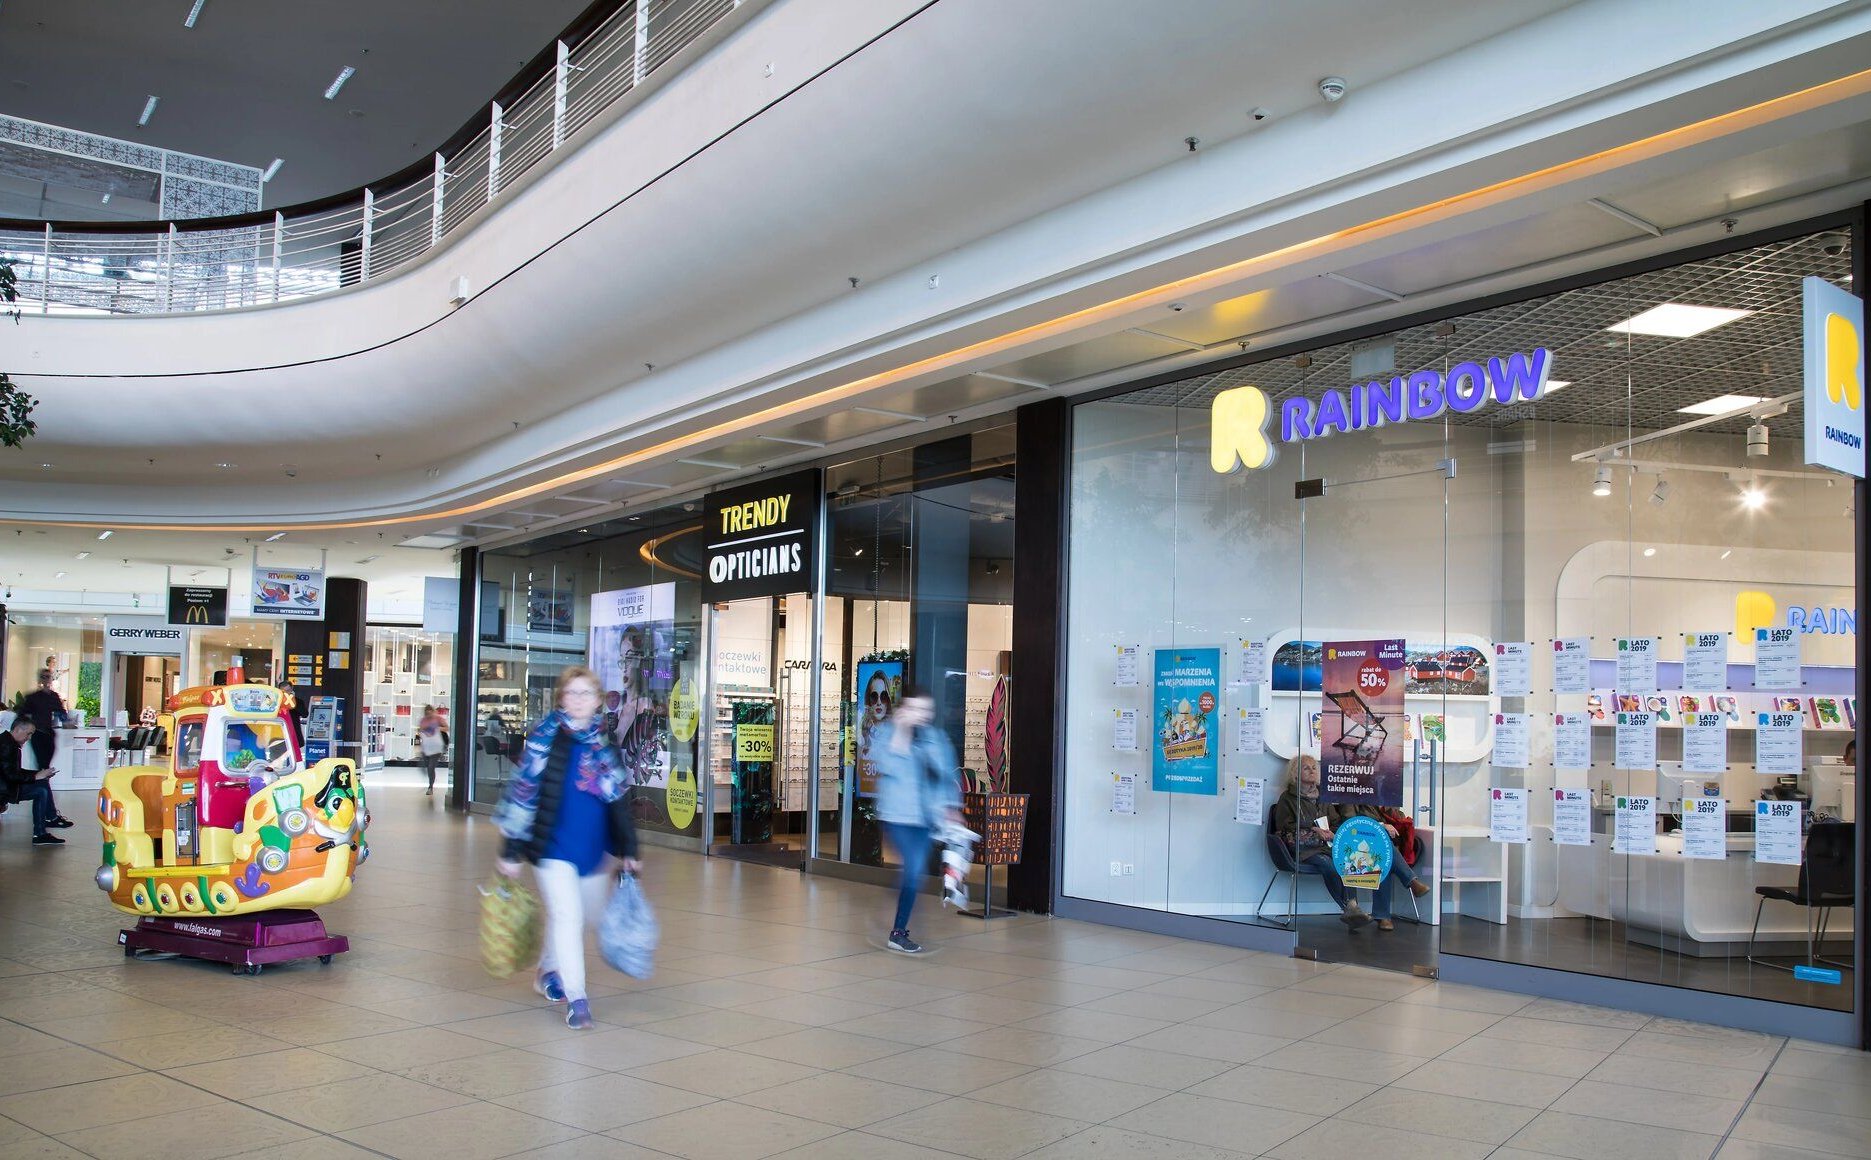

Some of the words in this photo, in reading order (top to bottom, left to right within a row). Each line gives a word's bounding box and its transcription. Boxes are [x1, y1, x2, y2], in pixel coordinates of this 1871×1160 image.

[1282, 347, 1552, 442] RAINBOW
[1825, 425, 1861, 450] RAINBOW
[720, 493, 791, 534] TRENDY
[709, 543, 801, 583] OPTICIANS
[110, 628, 143, 637] GERRY
[145, 629, 181, 639] WEBER
[1175, 668, 1212, 676] MARZENIA
[1360, 673, 1386, 687] 50%
[741, 740, 772, 752] -30%
[1328, 764, 1374, 775] REZERWUJ
[1327, 775, 1358, 783] Ostatnie
[1327, 784, 1345, 792] takie
[1346, 785, 1374, 795] miejsca
[174, 922, 221, 937] www.falgas.com
